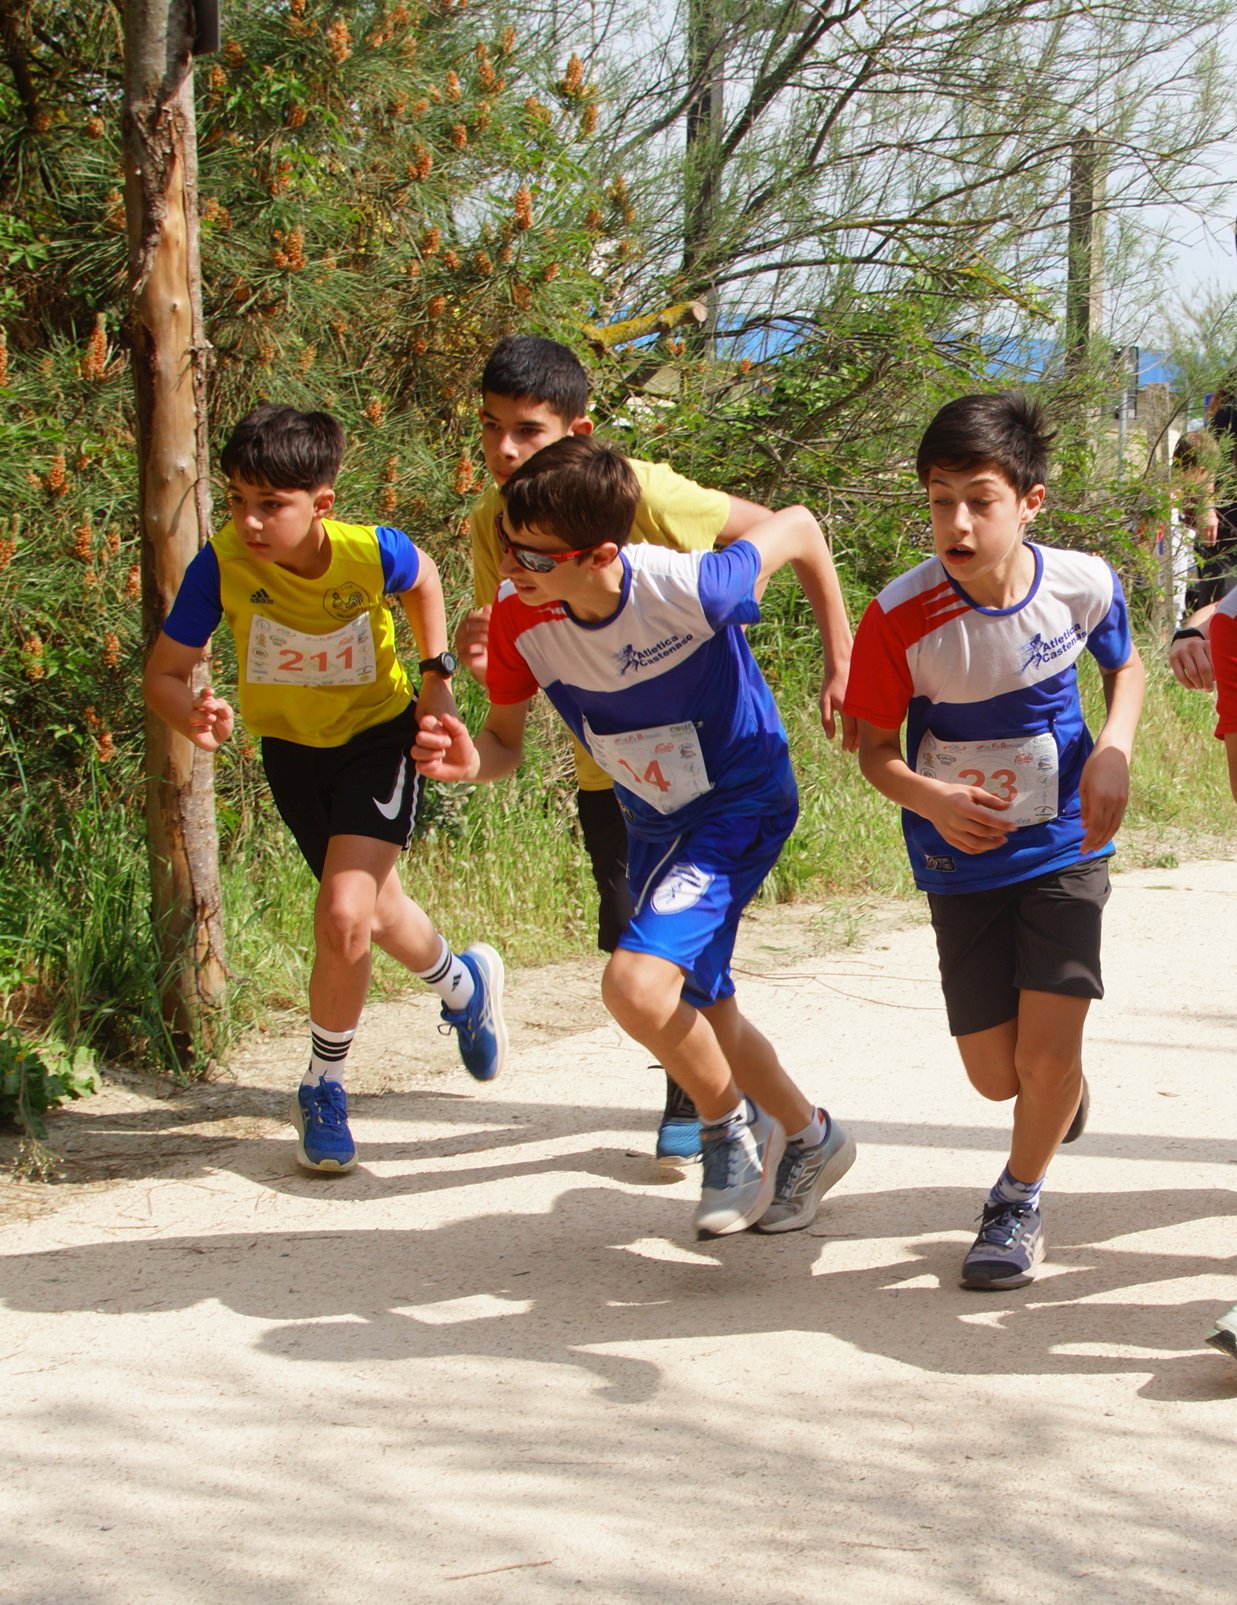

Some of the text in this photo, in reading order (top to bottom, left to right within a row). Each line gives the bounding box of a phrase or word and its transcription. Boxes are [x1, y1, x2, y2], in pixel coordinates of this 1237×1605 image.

[637, 635, 678, 660] Atletica
[640, 634, 693, 667] Castenaso
[1042, 631, 1088, 663] Castenas
[1043, 623, 1081, 652] Atletica
[278, 646, 353, 672] 211
[958, 768, 1018, 802] 23
